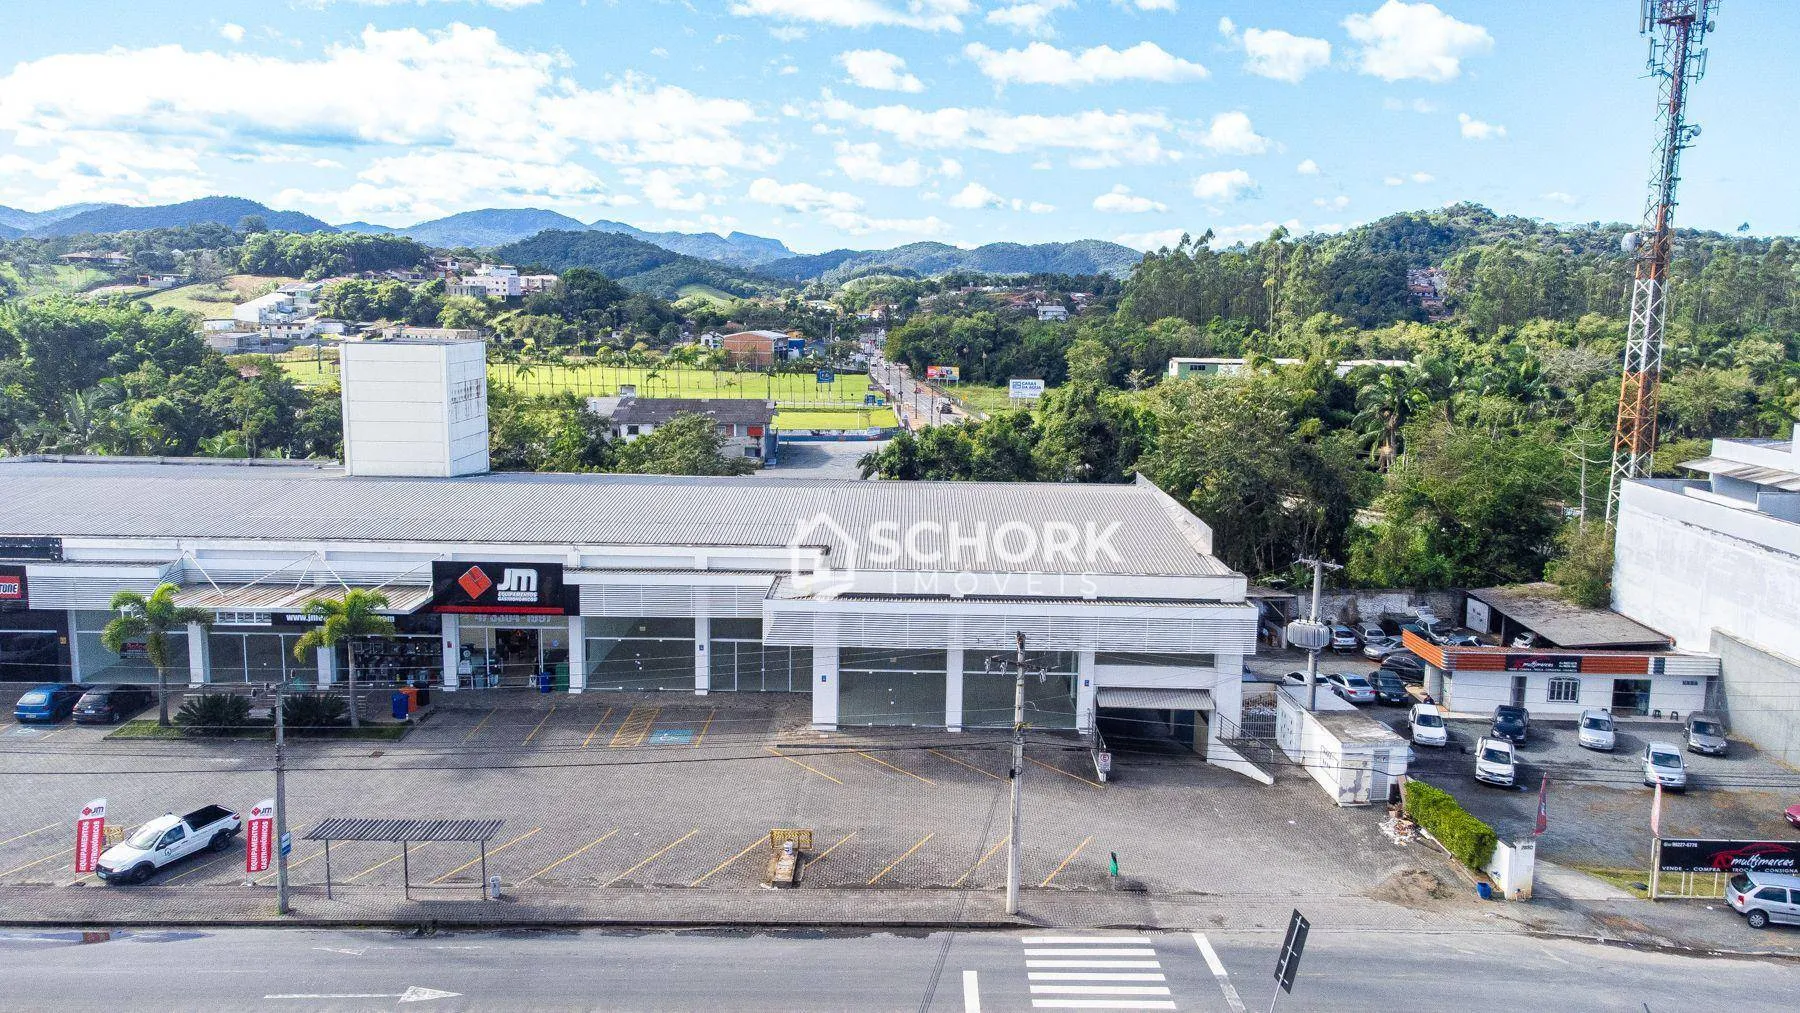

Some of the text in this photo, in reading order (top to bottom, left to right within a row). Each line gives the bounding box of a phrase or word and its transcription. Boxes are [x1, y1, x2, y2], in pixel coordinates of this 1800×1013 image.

[80, 820, 89, 871] EQUIPAMENTOS
[250, 820, 259, 871] EQUIPAMENTOS
[1731, 854, 1794, 868] multimarcas
